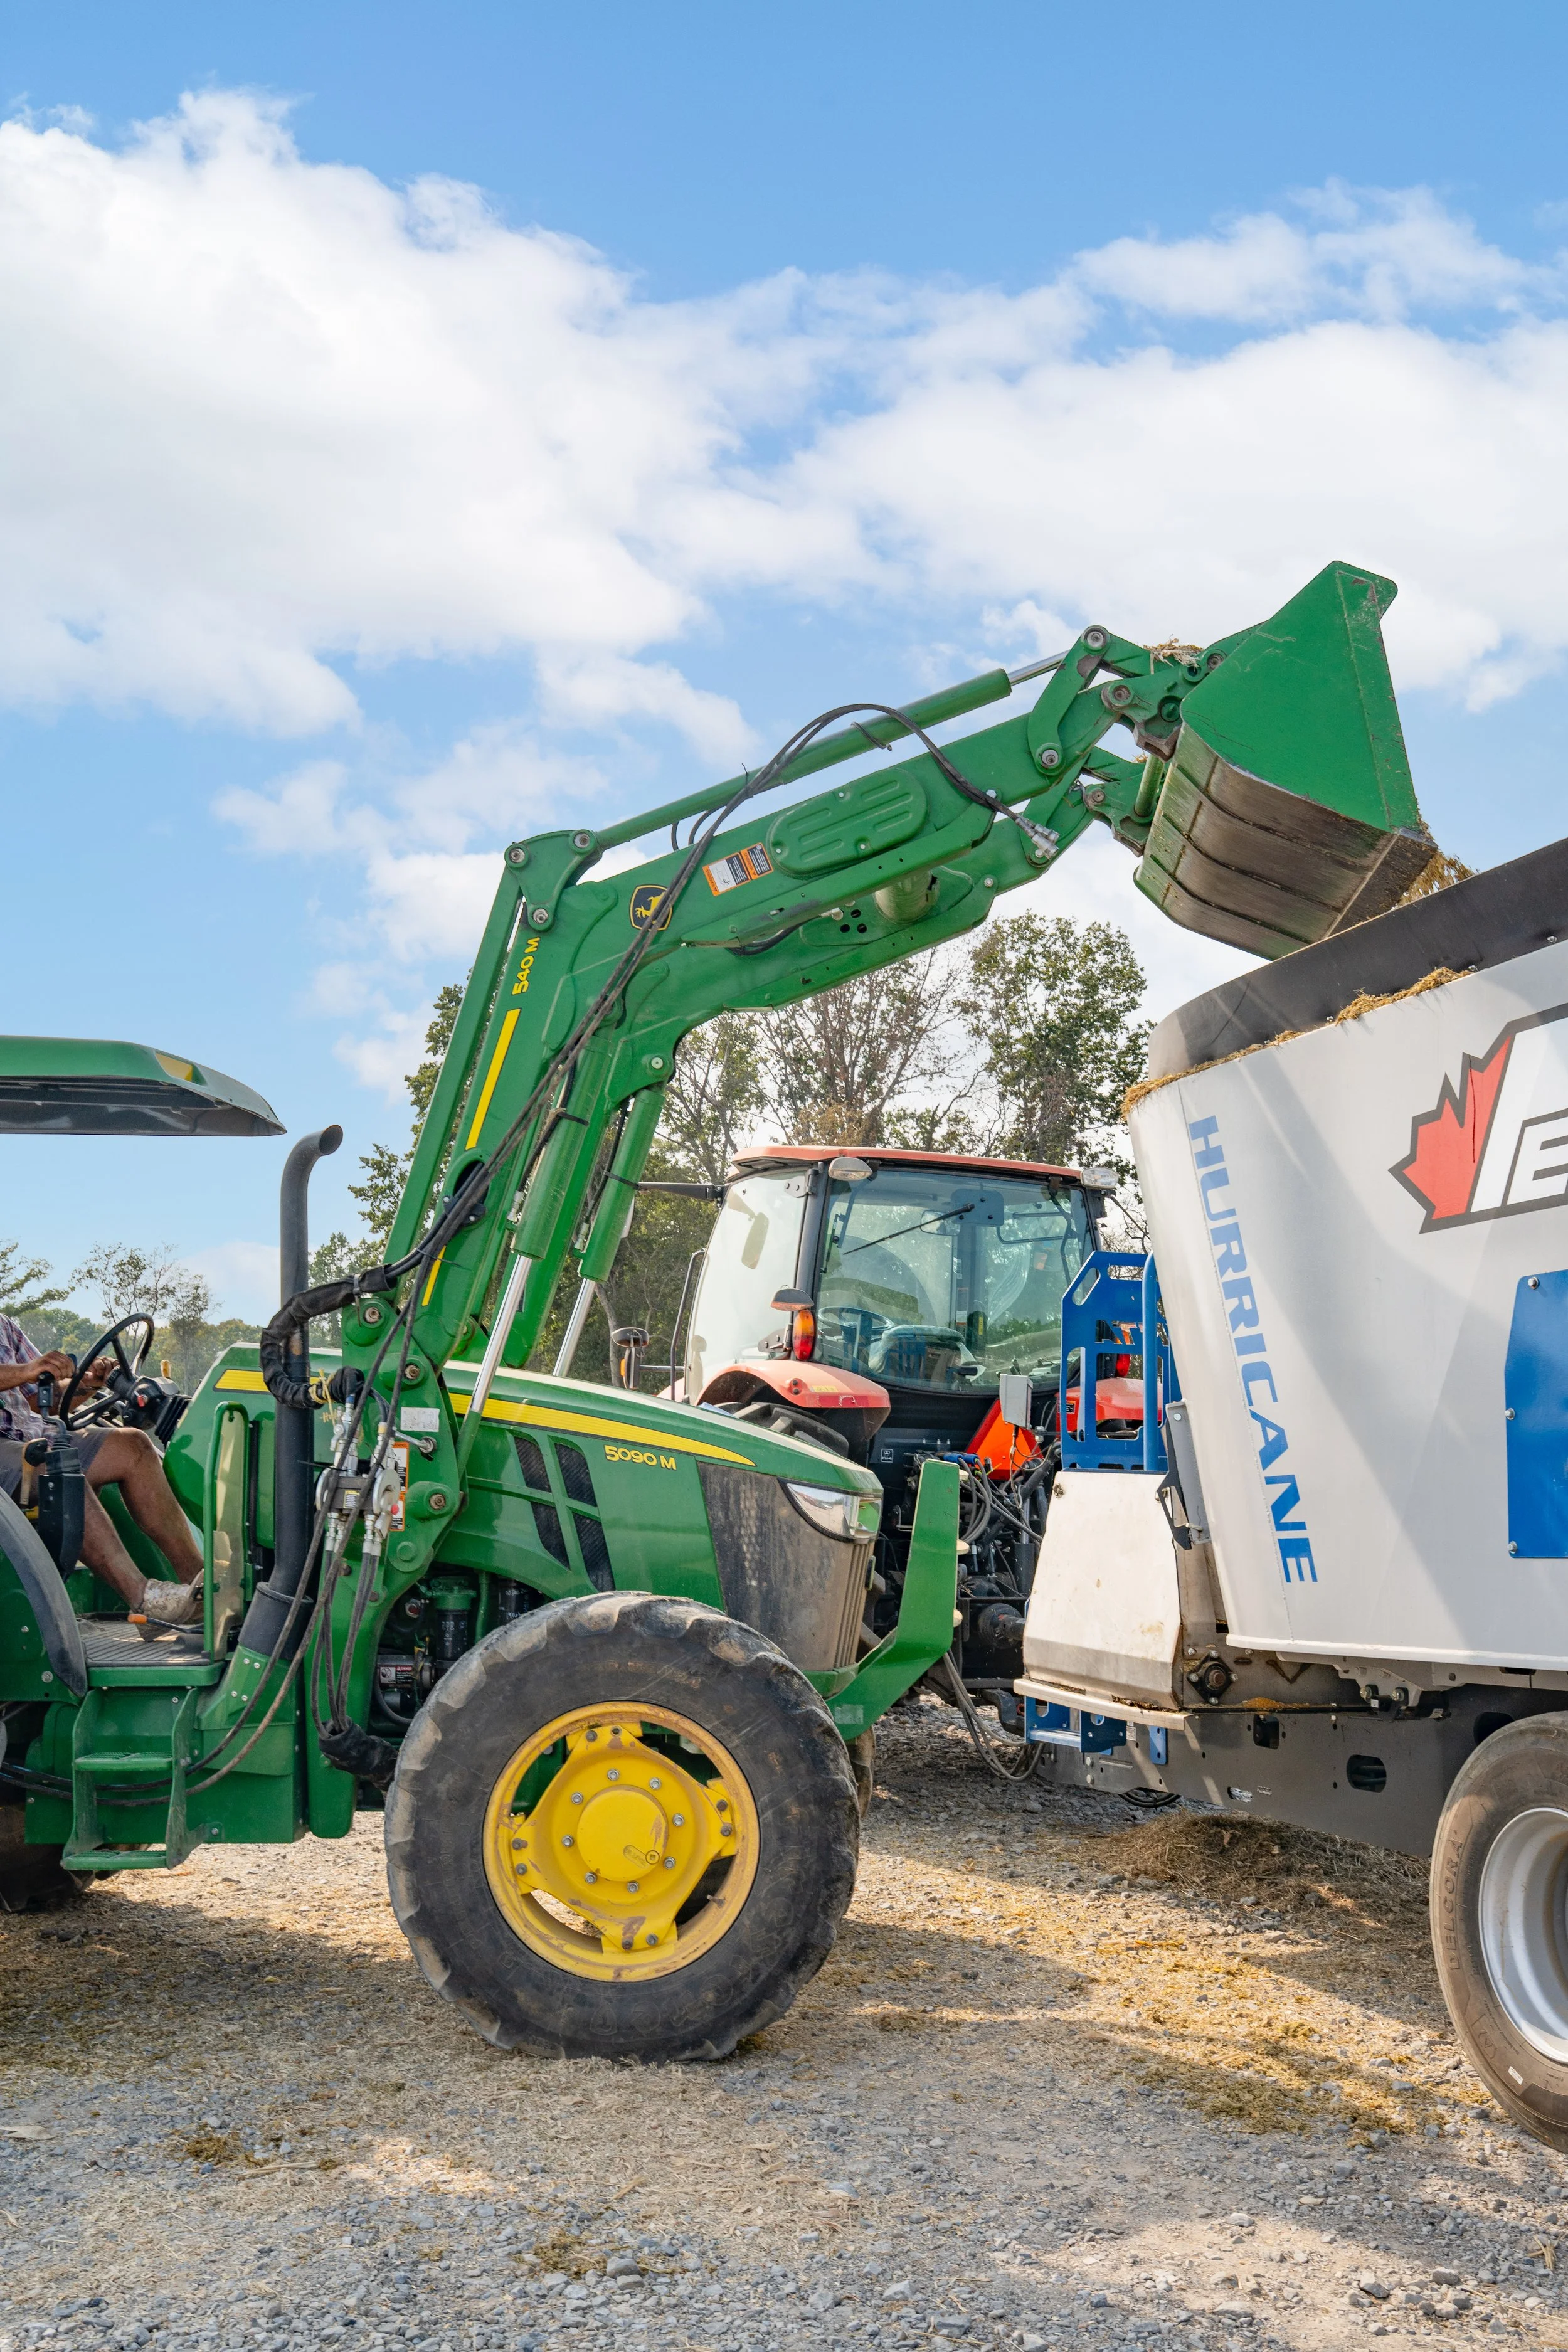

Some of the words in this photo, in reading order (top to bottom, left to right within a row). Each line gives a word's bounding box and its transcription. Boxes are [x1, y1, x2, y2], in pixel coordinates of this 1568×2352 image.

[511, 955, 534, 995] 540
[524, 936, 540, 953] M
[1189, 1115, 1318, 1582] HURRICANE
[604, 1444, 657, 1466] 5090
[659, 1454, 677, 1470] M
[1443, 1839, 1463, 1971] DELCORA
